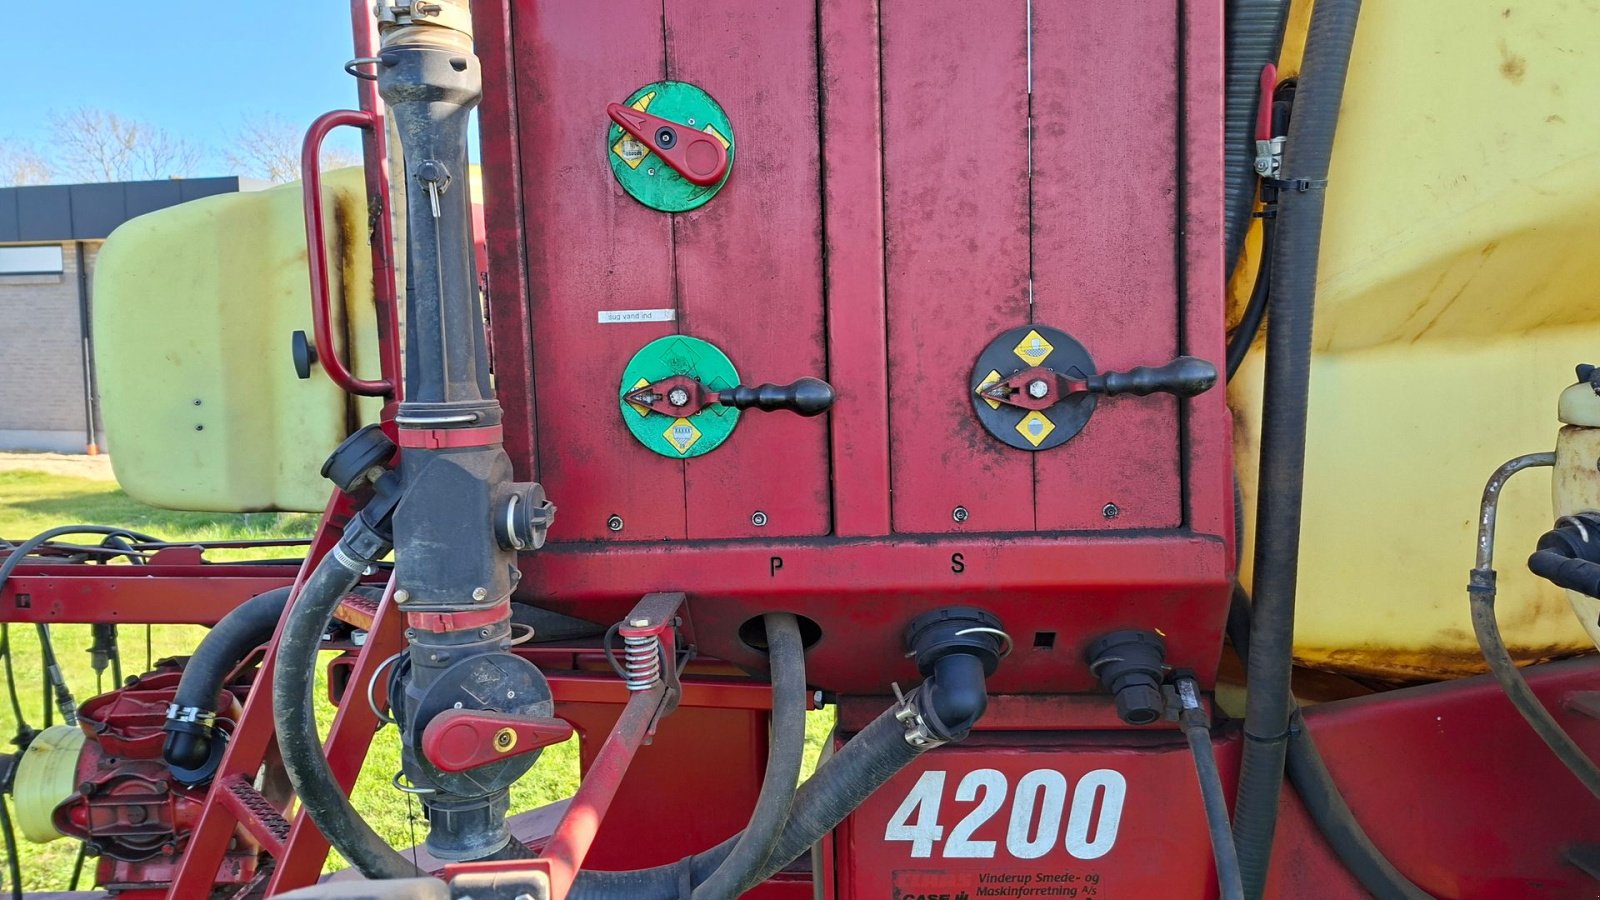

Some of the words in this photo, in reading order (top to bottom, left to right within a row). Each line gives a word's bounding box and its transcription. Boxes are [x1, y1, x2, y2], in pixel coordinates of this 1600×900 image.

[770, 556, 783, 577] P
[951, 553, 965, 573] S
[884, 768, 1127, 860] 4200
[978, 873, 1032, 885] Vinderup
[1036, 872, 1081, 883] Smede-
[1084, 873, 1100, 885] og
[976, 886, 1078, 899] Maskinforretning
